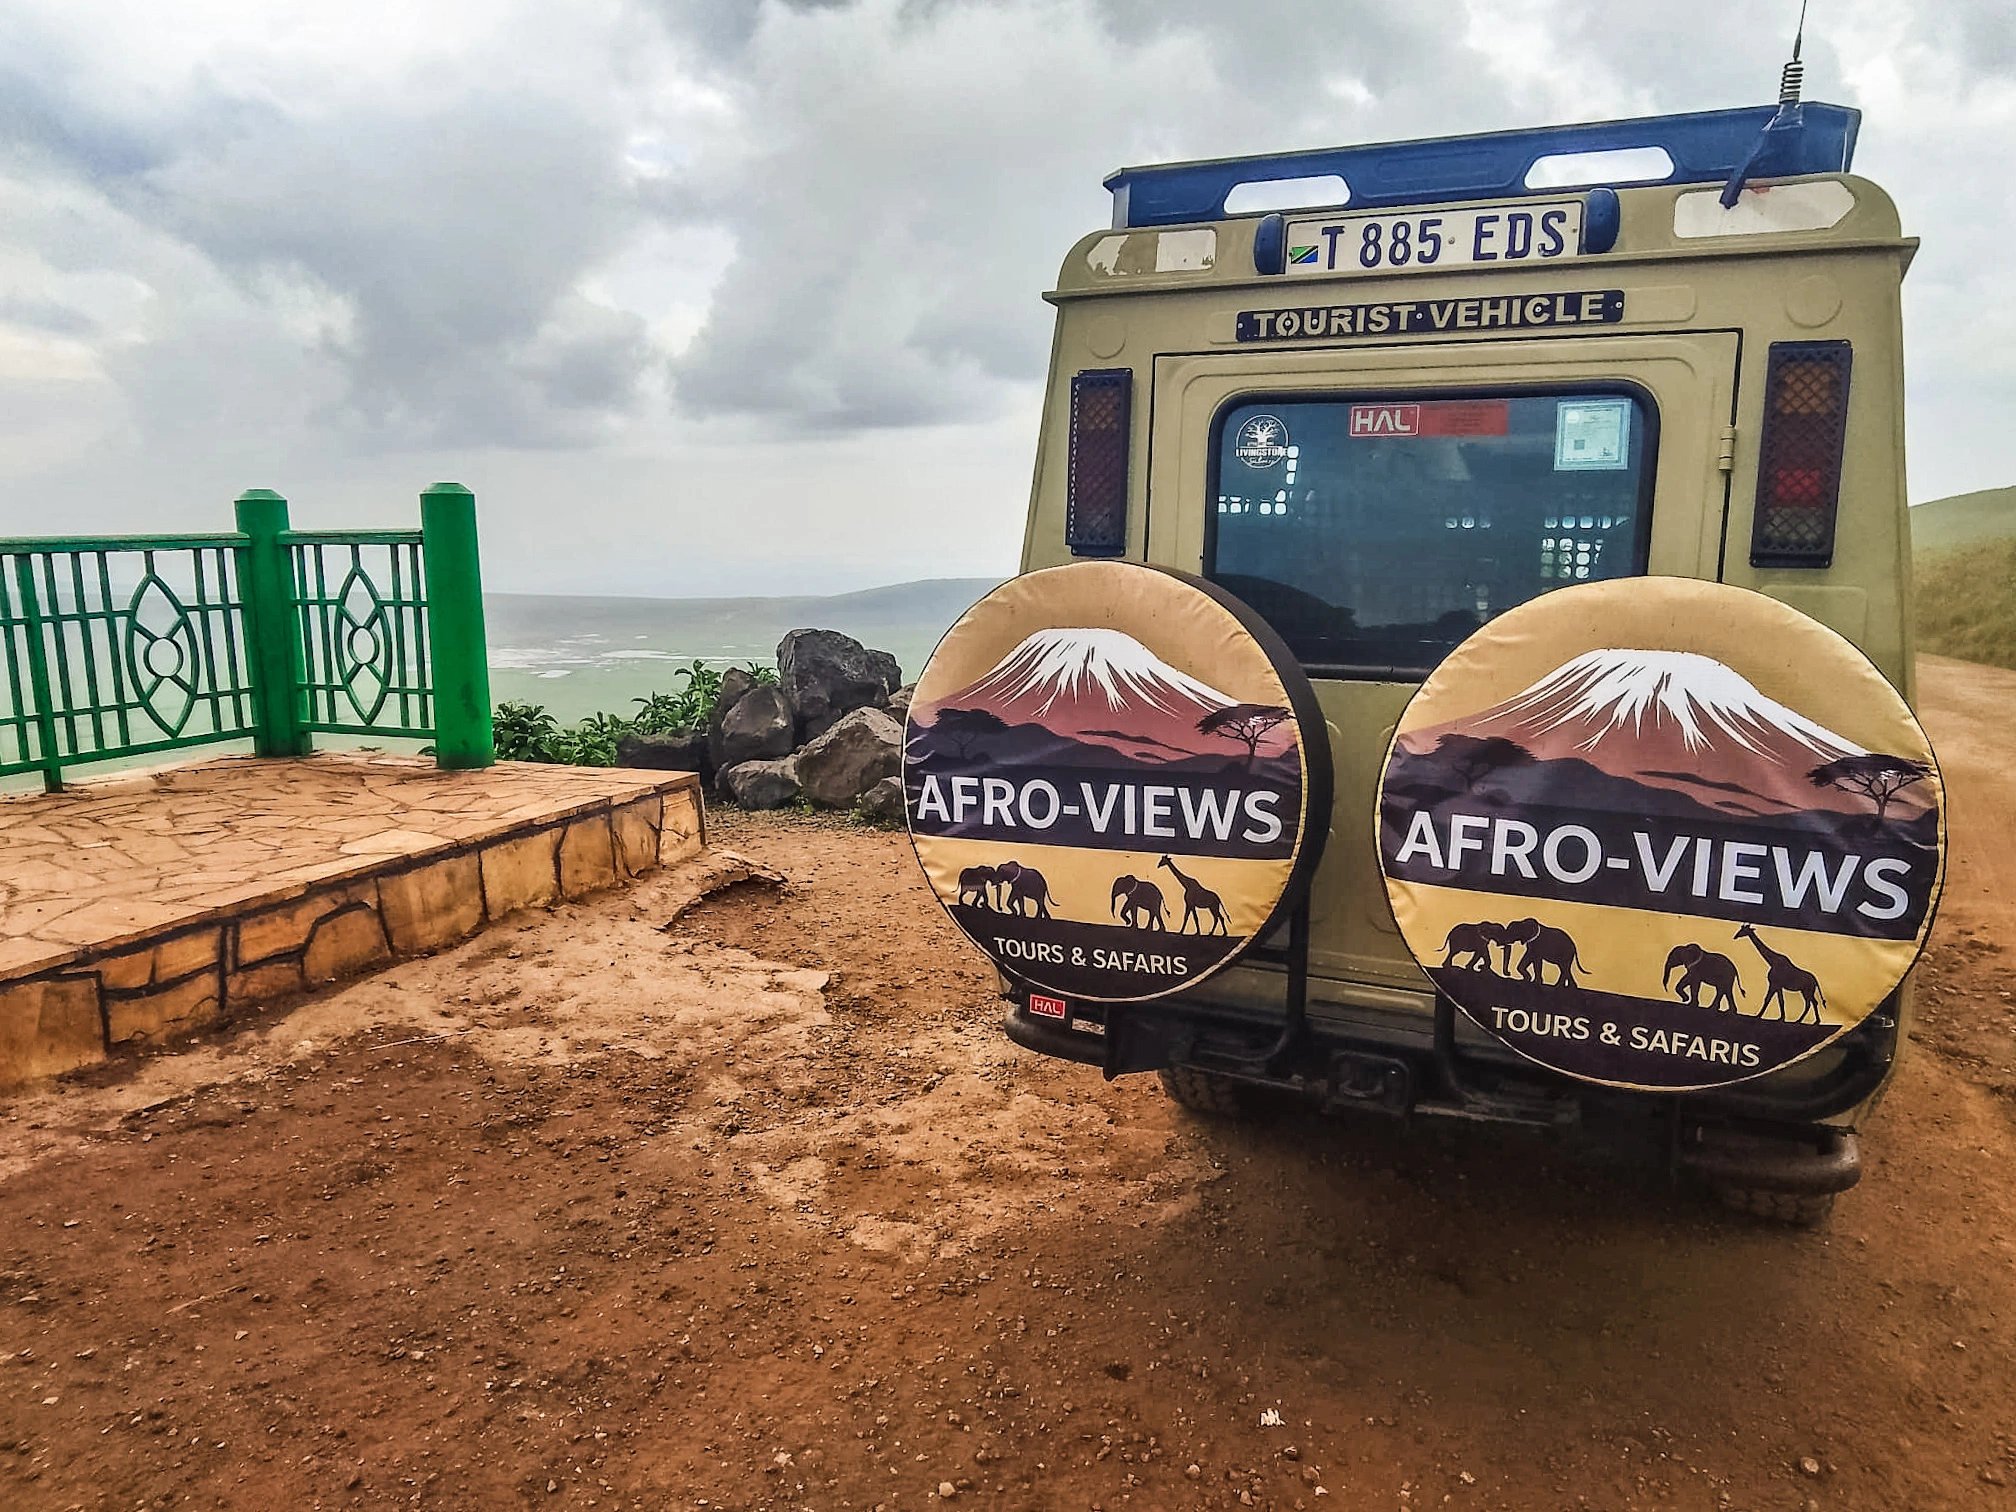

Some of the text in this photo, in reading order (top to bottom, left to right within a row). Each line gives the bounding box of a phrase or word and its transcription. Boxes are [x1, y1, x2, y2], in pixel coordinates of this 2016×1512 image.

[1321, 210, 1566, 270] T 885 EDS
[1253, 294, 1604, 338] TOURIST VEHICLE
[1355, 409, 1411, 432] HAL
[917, 774, 1282, 843] AFRO-VIEWS
[1395, 810, 1912, 921] AFRO-VIEWS
[993, 937, 1188, 975] TOURS & SAFARIS
[1034, 999, 1061, 1014] HAL
[1491, 1007, 1761, 1067] TOURS & SAFARIS
